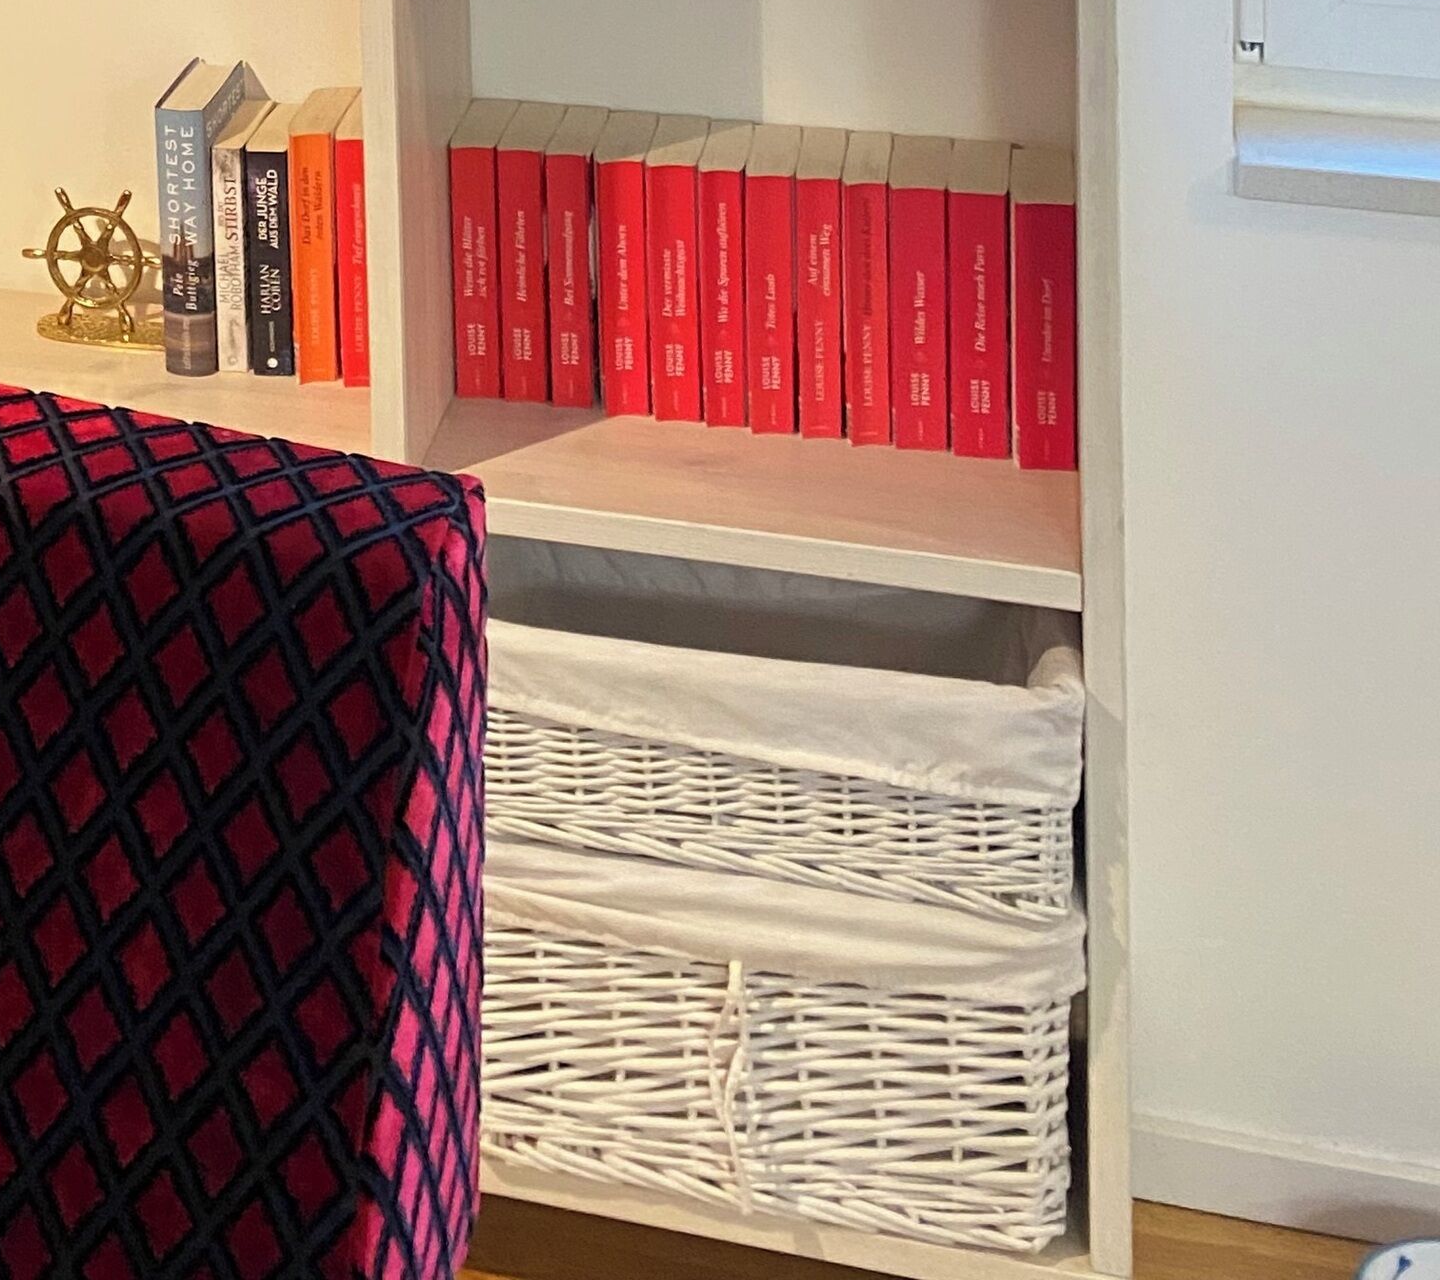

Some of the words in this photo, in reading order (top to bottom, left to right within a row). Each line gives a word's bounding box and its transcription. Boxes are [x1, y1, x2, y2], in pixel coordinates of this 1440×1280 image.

[181, 126, 195, 190] HOME
[164, 125, 182, 245] SHORTEST
[256, 178, 267, 219] JUNGE
[267, 169, 278, 205] WALD
[184, 203, 196, 246] WAY
[223, 177, 238, 241] STIRBST
[269, 207, 278, 228] DEM
[258, 221, 268, 240] DER
[269, 230, 279, 249] AUS
[172, 273, 185, 297] Pete
[185, 260, 200, 310] Buttigieg
[229, 245, 242, 311] ROBOTHAM
[260, 264, 272, 314] HARLAN
[270, 268, 281, 311] COBEN
[616, 282, 628, 311] Unter
[468, 324, 477, 356] LOUISE
[477, 324, 487, 356] PENNY
[914, 311, 926, 344] Wildes
[560, 332, 570, 365] LOUISE
[570, 333, 580, 365] PENNY
[615, 338, 625, 370] LOUISE
[624, 337, 634, 370] PENNY
[675, 343, 685, 376] PENNY
[714, 351, 724, 384] LOUISE
[724, 350, 734, 383] PENNY
[761, 357, 770, 390] LOUISE
[770, 356, 781, 390] PENNY
[910, 373, 920, 406] LOUISE
[920, 373, 930, 406] PENNY
